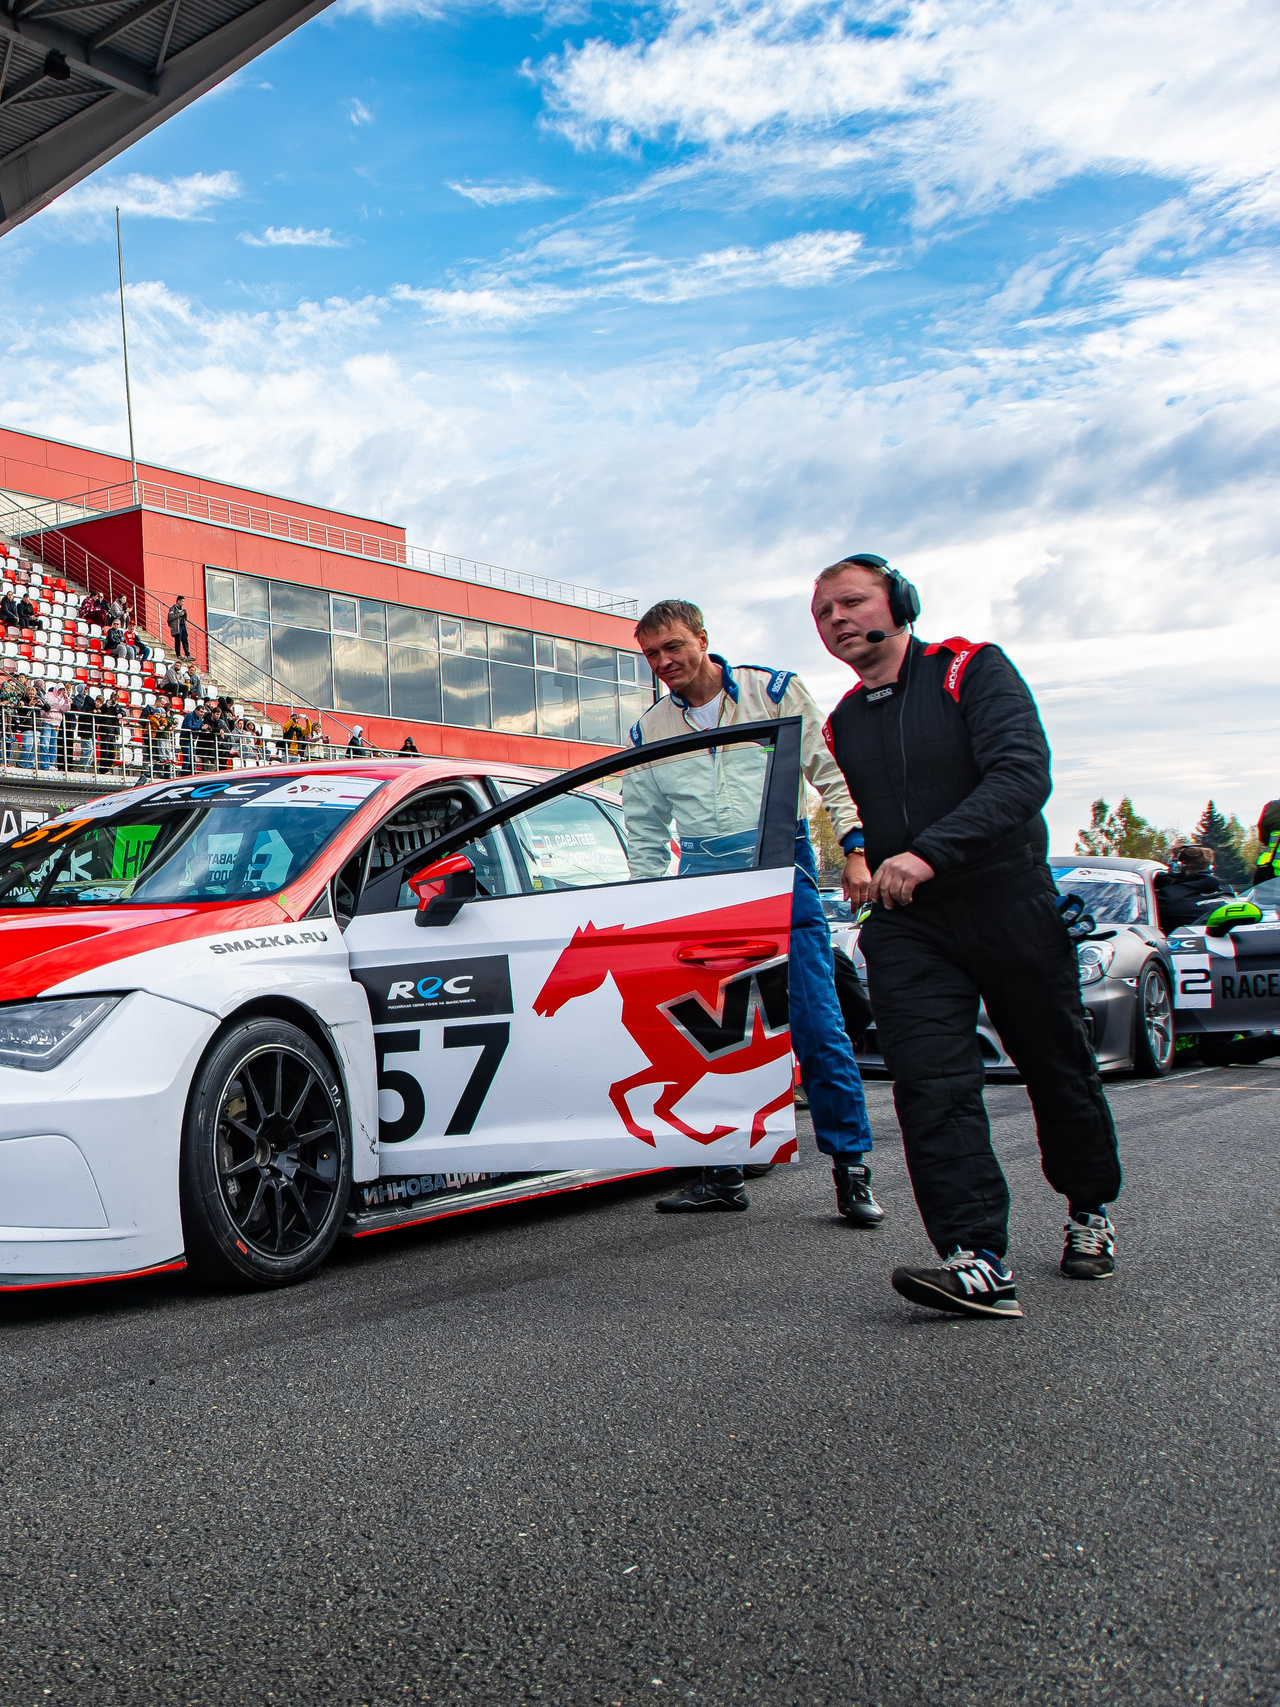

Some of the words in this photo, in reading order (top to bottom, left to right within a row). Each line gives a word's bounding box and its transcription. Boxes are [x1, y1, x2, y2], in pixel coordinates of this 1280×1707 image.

[948, 650, 968, 690] sparco
[555, 833, 597, 848] САВАТЕЕВ
[209, 931, 328, 954] SMAZKA.RU
[378, 1021, 511, 1144] 57
